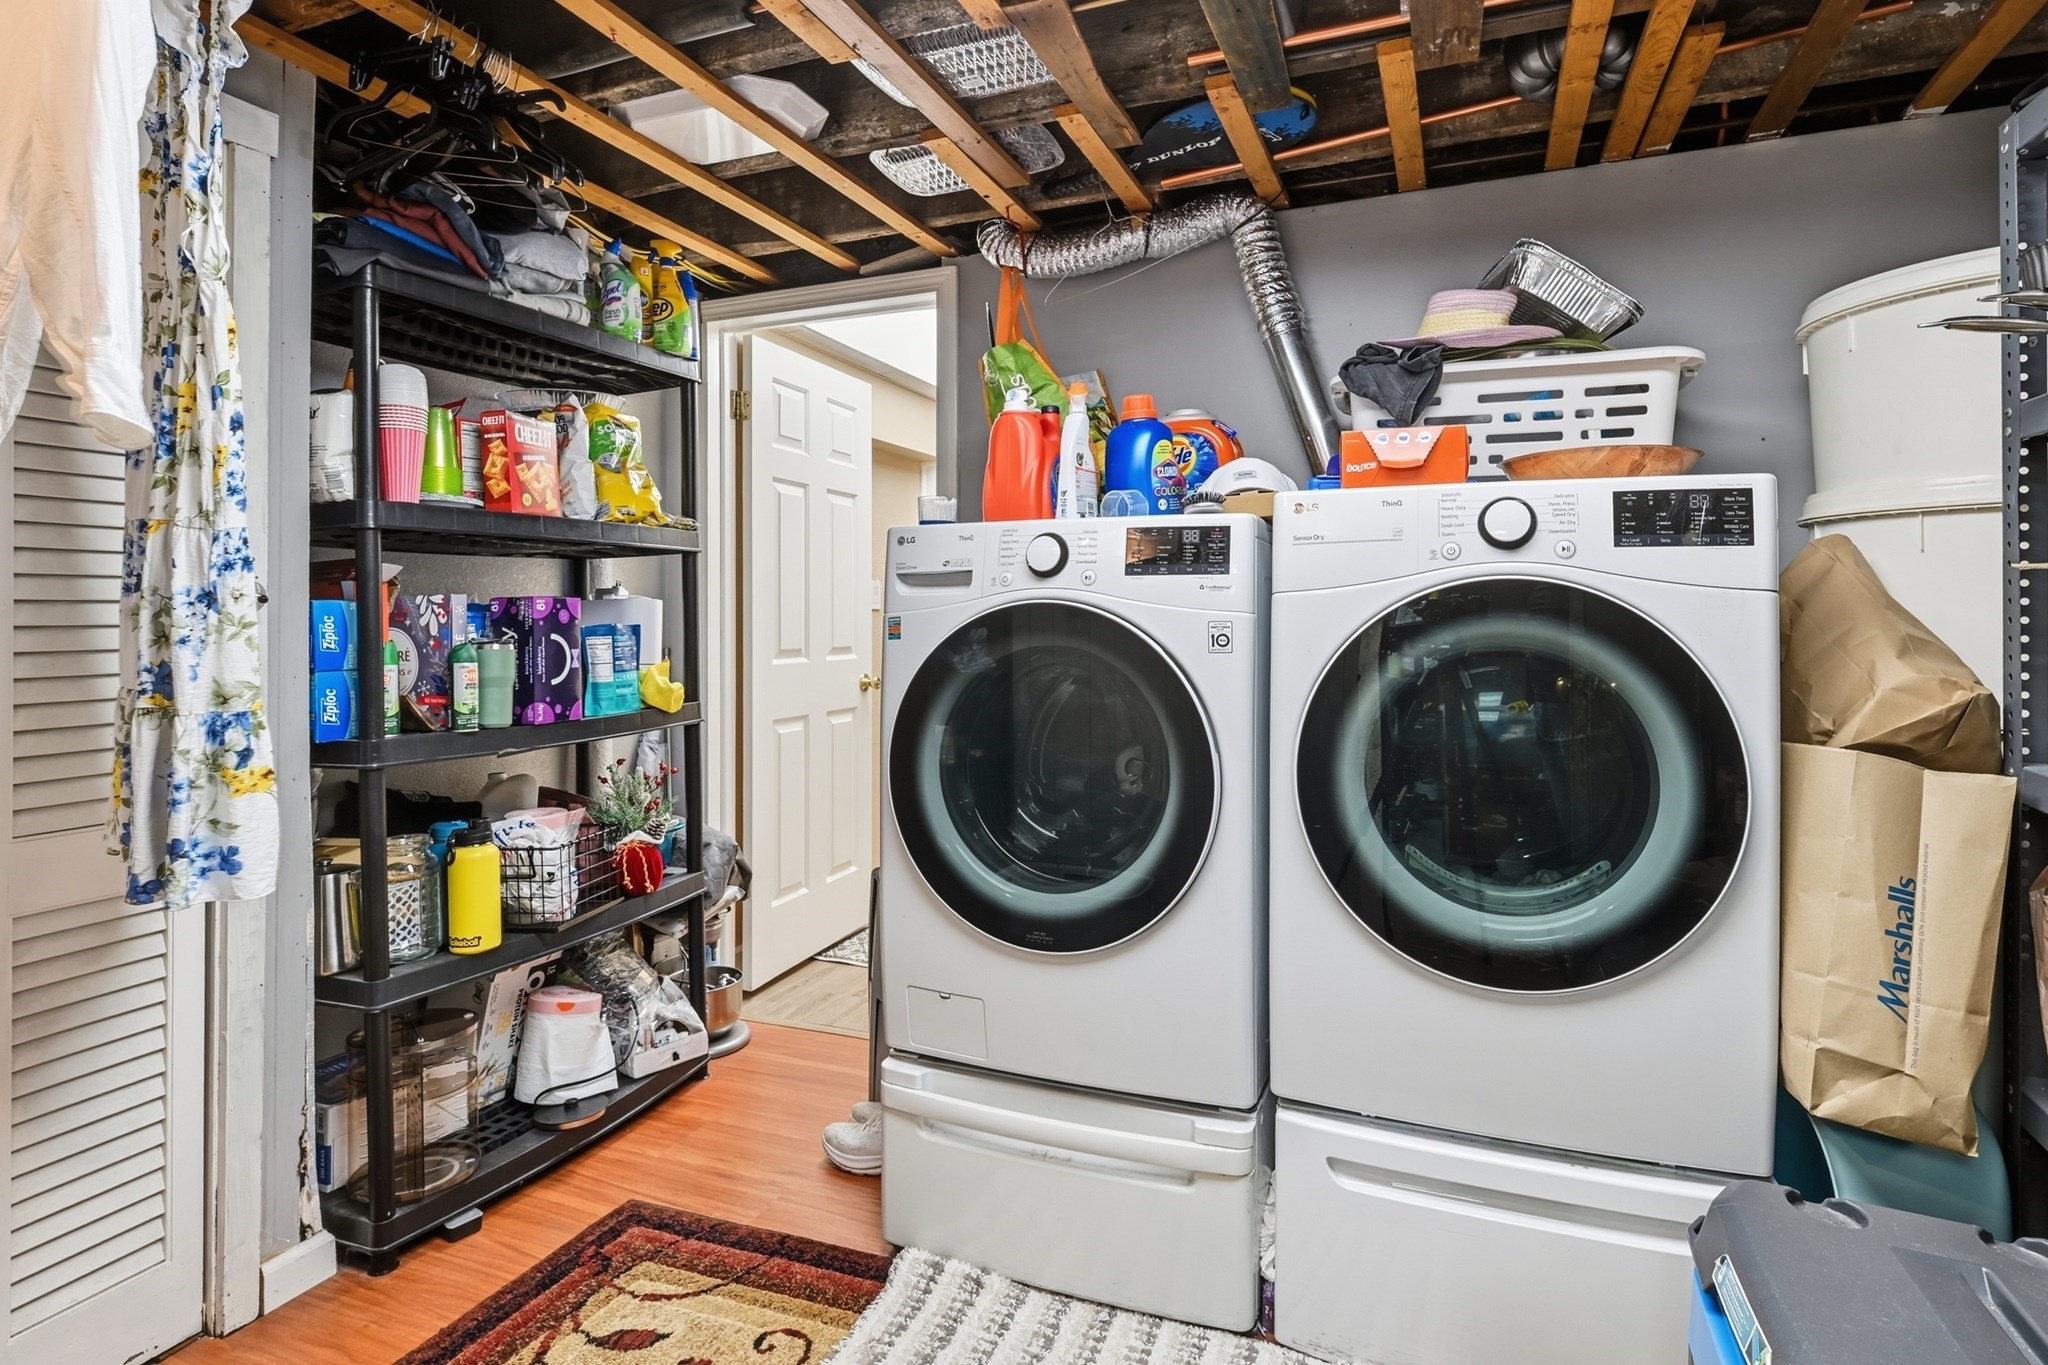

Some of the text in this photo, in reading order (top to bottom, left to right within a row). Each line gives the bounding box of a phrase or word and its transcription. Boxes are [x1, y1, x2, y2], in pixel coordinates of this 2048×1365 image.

[1146, 136, 1223, 164] DUNLOP
[652, 301, 669, 316] ep
[1346, 461, 1377, 473] bounce
[1306, 503, 1319, 512] LG
[1381, 499, 1402, 507] ThinQ
[906, 536, 916, 544] LG
[322, 615, 339, 650] Ziploc
[323, 688, 340, 722] Ziploc
[1876, 875, 1916, 1024] Marshalls
[1911, 1047, 1920, 1058] bag
[1910, 1058, 1918, 1070] This
